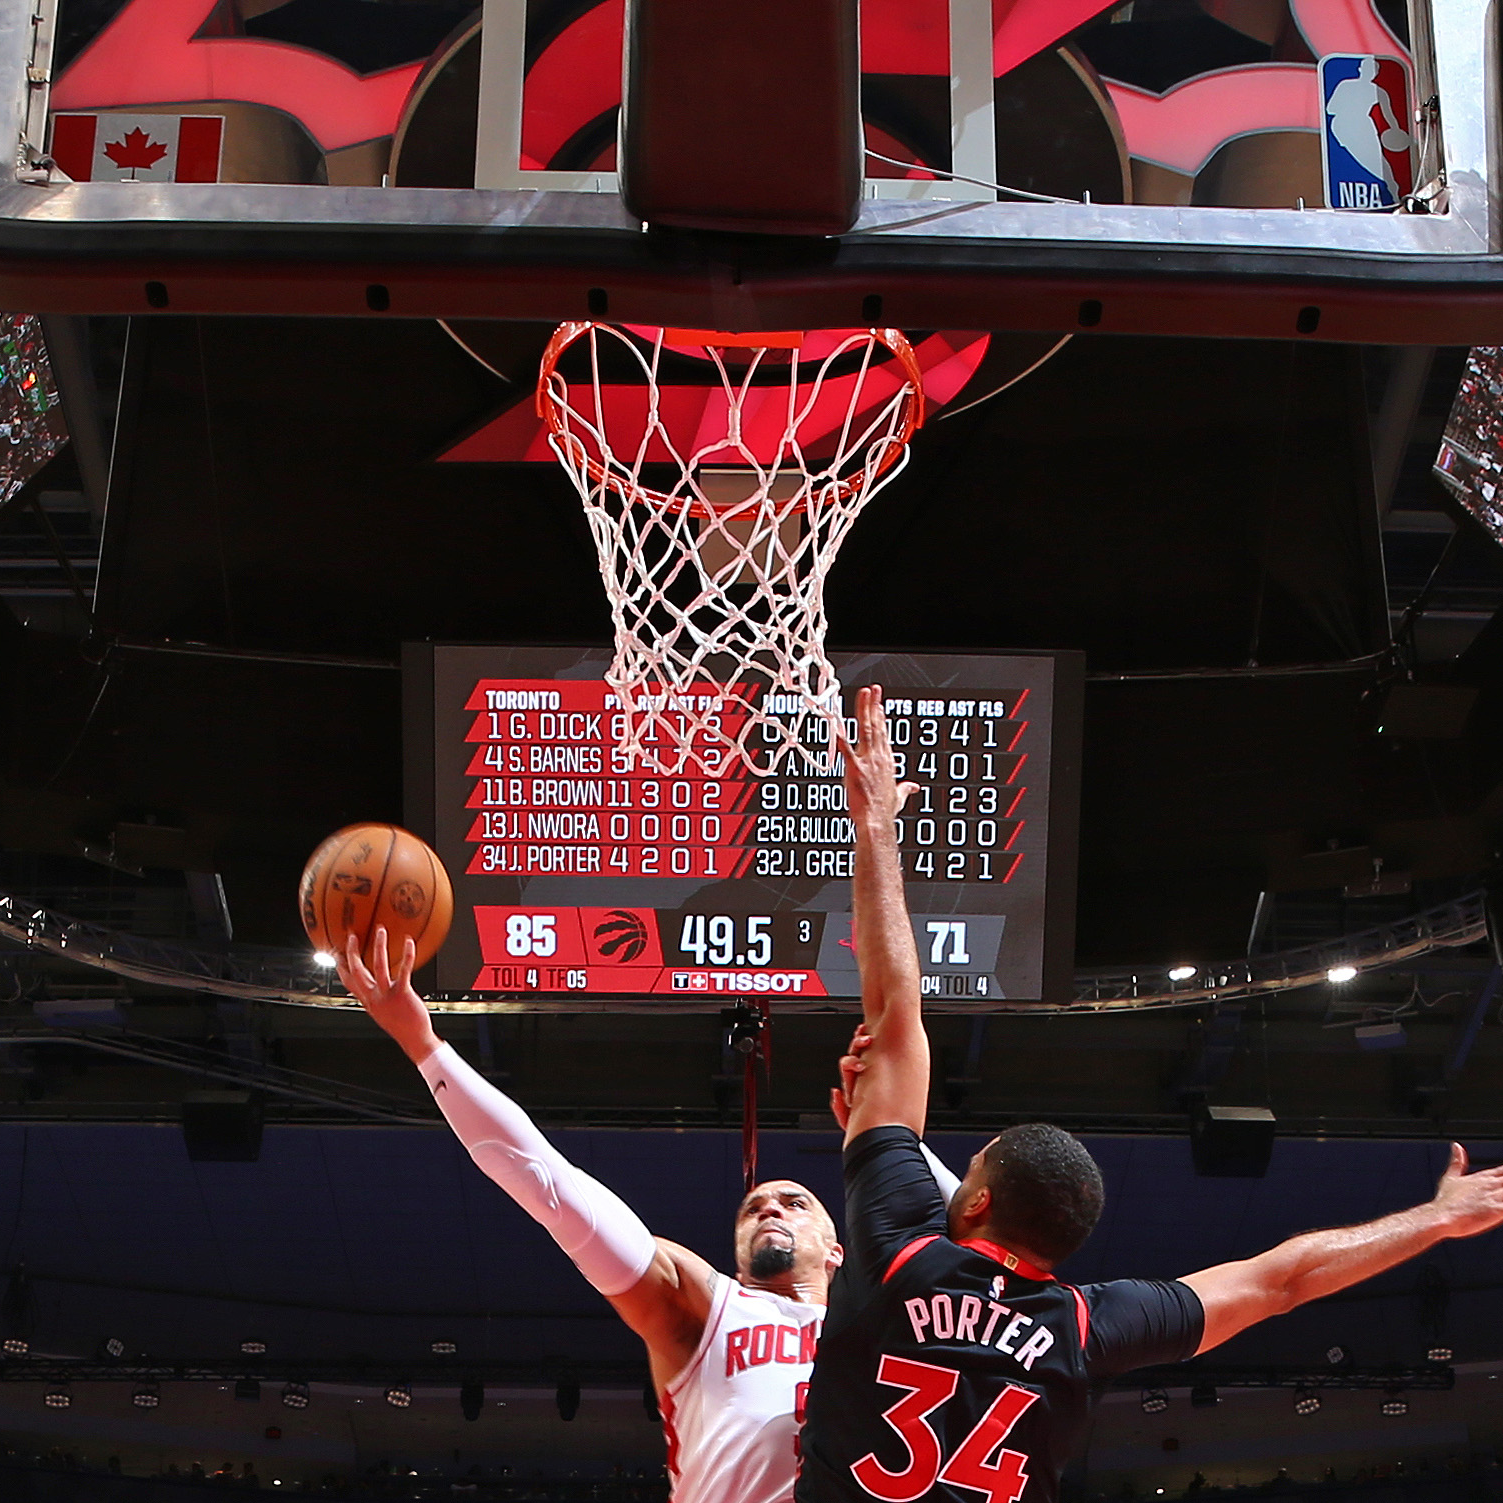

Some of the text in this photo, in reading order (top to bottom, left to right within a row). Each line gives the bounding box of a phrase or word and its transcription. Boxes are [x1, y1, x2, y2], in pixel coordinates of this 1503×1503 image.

[1339, 181, 1383, 208] NBA
[485, 690, 560, 711] TORONTO
[885, 699, 1004, 718] PTS REB AST FLS
[488, 713, 601, 740] 1 G. DICK
[919, 720, 938, 745] 3
[950, 720, 969, 746] 4
[983, 720, 997, 747] 1
[485, 746, 503, 771] 4
[509, 746, 525, 772] S.
[530, 747, 602, 773] BARNES
[611, 748, 628, 774] 5
[918, 752, 937, 779] 4
[950, 753, 968, 780] 0
[983, 754, 996, 780] 1
[482, 778, 721, 809] 11 B. BROWN 11 3 0 2
[761, 783, 997, 814] 9 D. 1 2 3
[482, 813, 721, 842] 13 J. NWORA 0 0 0 0
[757, 816, 783, 842] 25
[785, 817, 797, 842] R.
[800, 817, 856, 844] BULLOCK
[917, 819, 936, 845] 0
[947, 820, 966, 846] 0
[978, 820, 997, 847] 0
[482, 846, 718, 875] 34 J. PORTER 4 2 0 1
[756, 850, 993, 880] 32 J. 4 2 1
[506, 914, 557, 957] 85
[680, 915, 773, 966] 49.5
[799, 920, 811, 943] 3
[926, 921, 970, 964] 71
[491, 967, 521, 988] TOL
[526, 969, 538, 988] 4
[566, 969, 587, 989] 05
[709, 972, 808, 992] TISSOT
[921, 975, 988, 995] 04 TOL 4
[904, 1293, 1056, 1372] PORTER
[725, 1319, 823, 1380] ROCK
